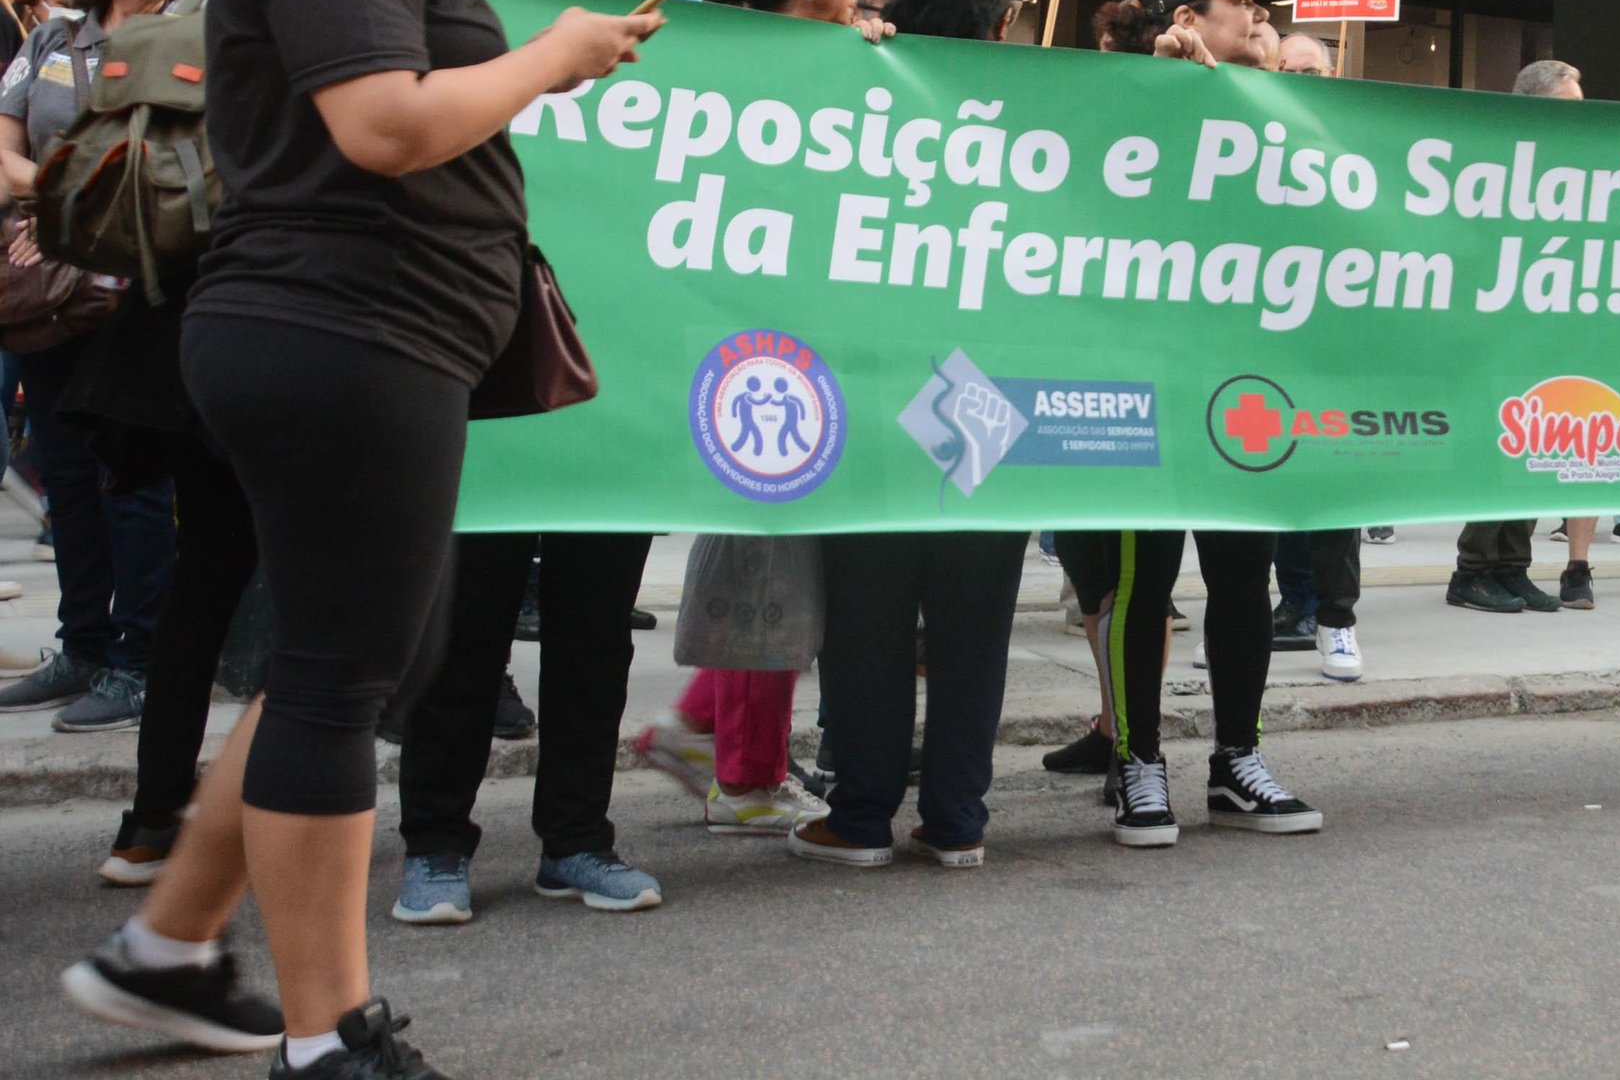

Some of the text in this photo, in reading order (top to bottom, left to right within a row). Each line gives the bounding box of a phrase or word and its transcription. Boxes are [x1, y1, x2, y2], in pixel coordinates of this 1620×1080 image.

[1102, 134, 1160, 200] e
[1187, 118, 1379, 212] Piso
[646, 173, 794, 277] da
[828, 192, 1455, 331] Enfermagem
[719, 331, 815, 371] ASHPS
[1034, 390, 1152, 419] ASSERPV
[1290, 409, 1449, 437] ASSMS
[712, 453, 762, 492] SERVIDORES
[763, 483, 777, 493] DO
[778, 469, 817, 493] HOSPITAL
